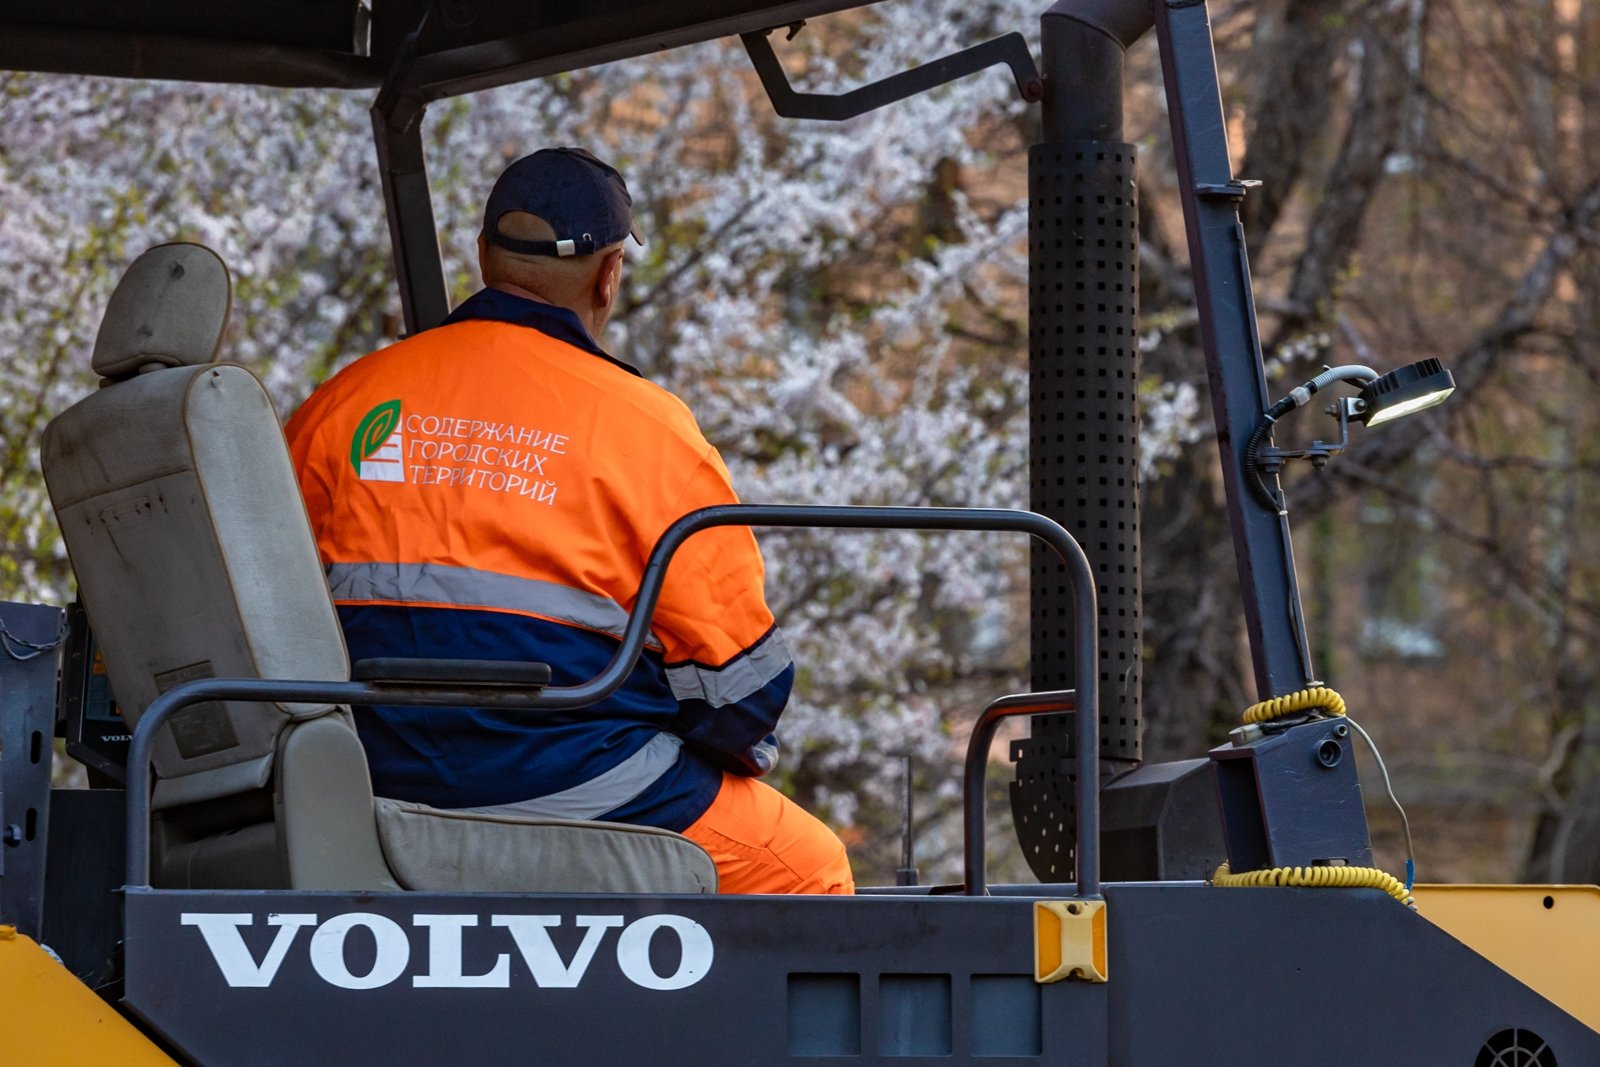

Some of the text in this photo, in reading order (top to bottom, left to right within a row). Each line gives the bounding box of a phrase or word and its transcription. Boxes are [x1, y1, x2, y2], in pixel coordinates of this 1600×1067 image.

[405, 414, 569, 455] СОДЕРЖАНИЕ
[408, 439, 548, 476] ГОРОДСКИХ
[409, 464, 559, 506] ТЕРРИТОРИЙ
[180, 912, 714, 990] VOLVO
